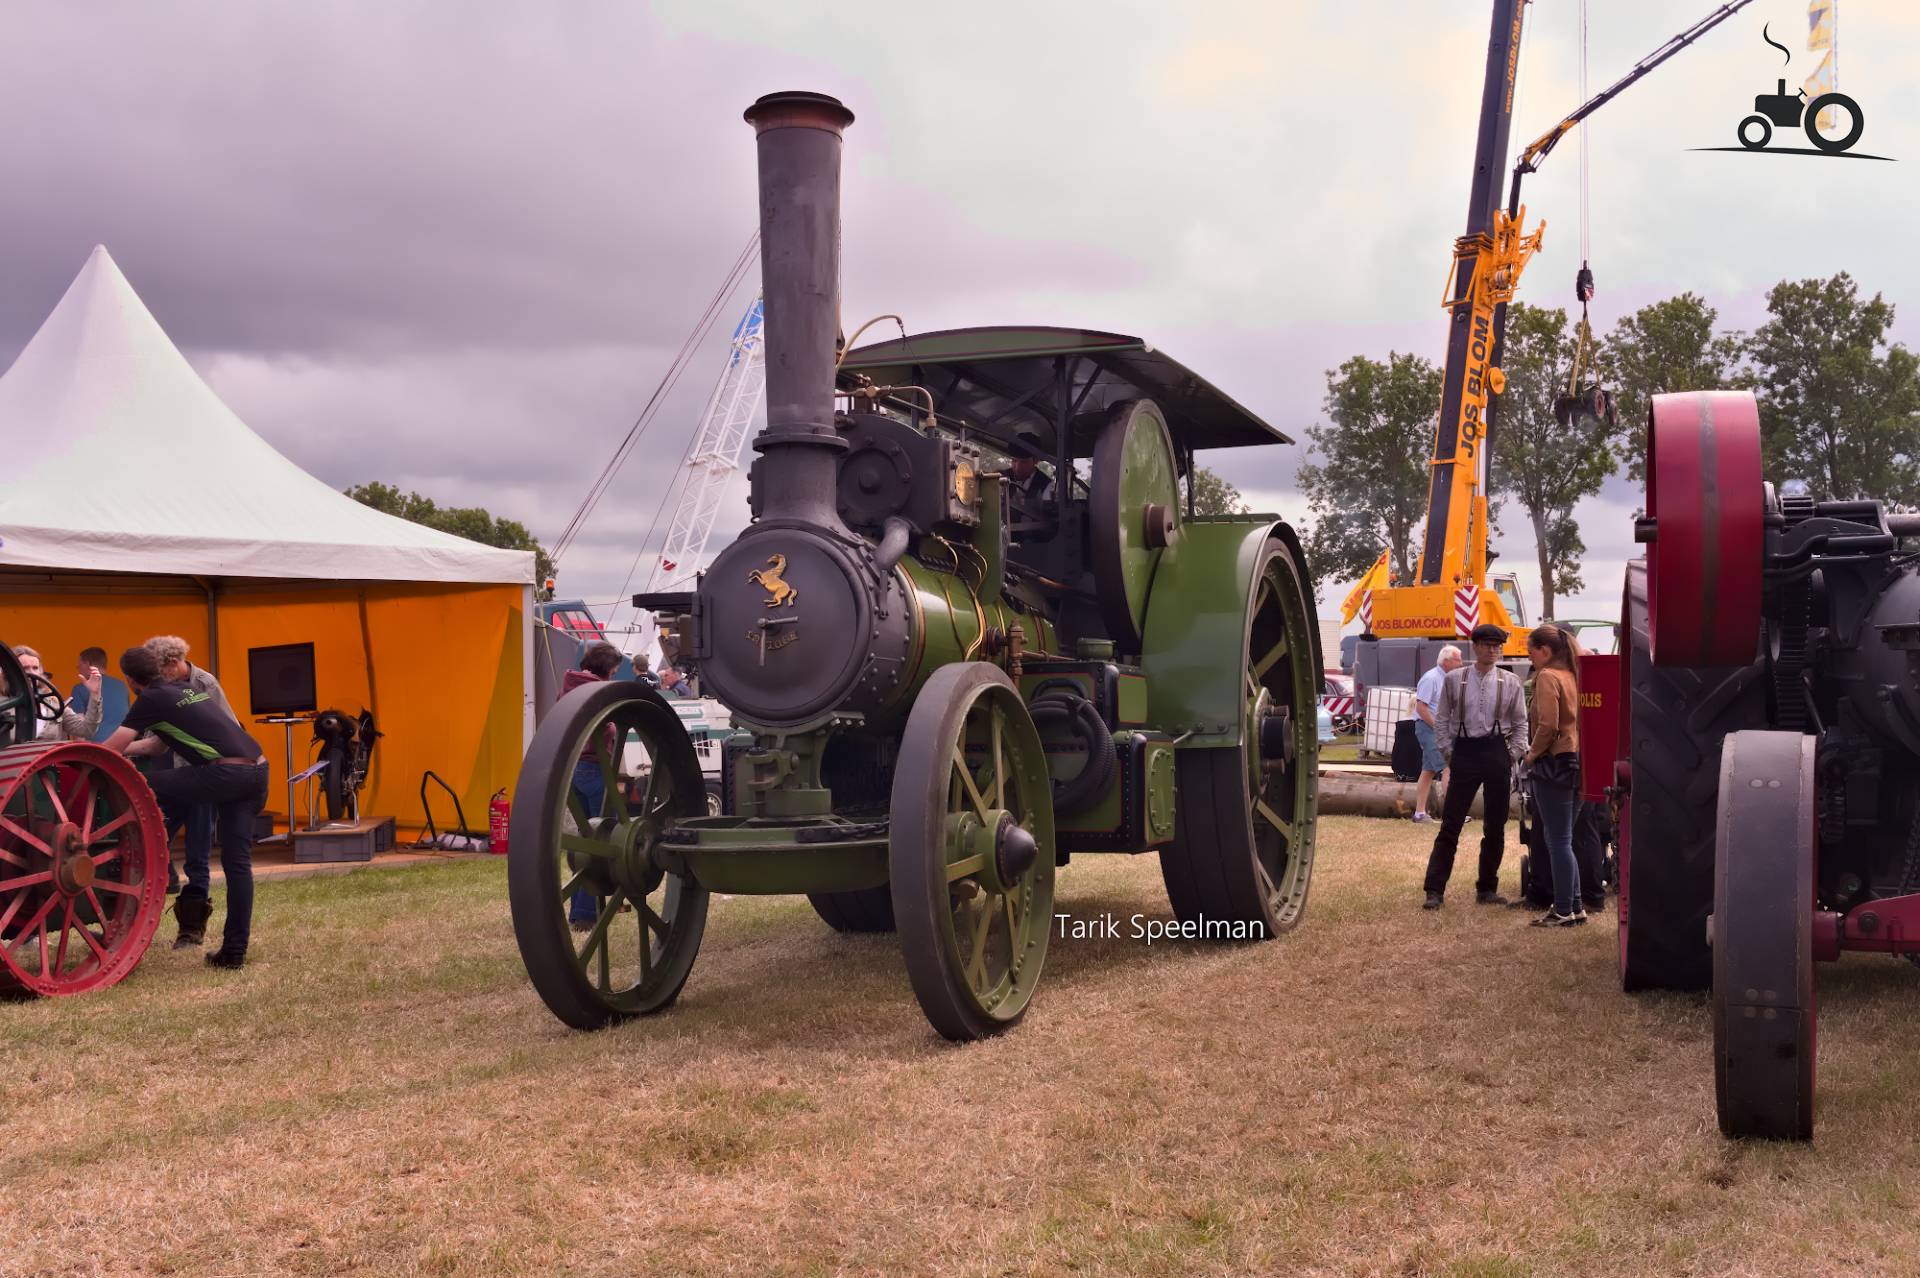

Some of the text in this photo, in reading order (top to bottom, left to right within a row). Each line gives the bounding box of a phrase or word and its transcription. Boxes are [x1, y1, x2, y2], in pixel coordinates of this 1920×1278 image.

[1461, 315, 1489, 459] JOS BLOM
[1577, 692, 1602, 708] OLIS
